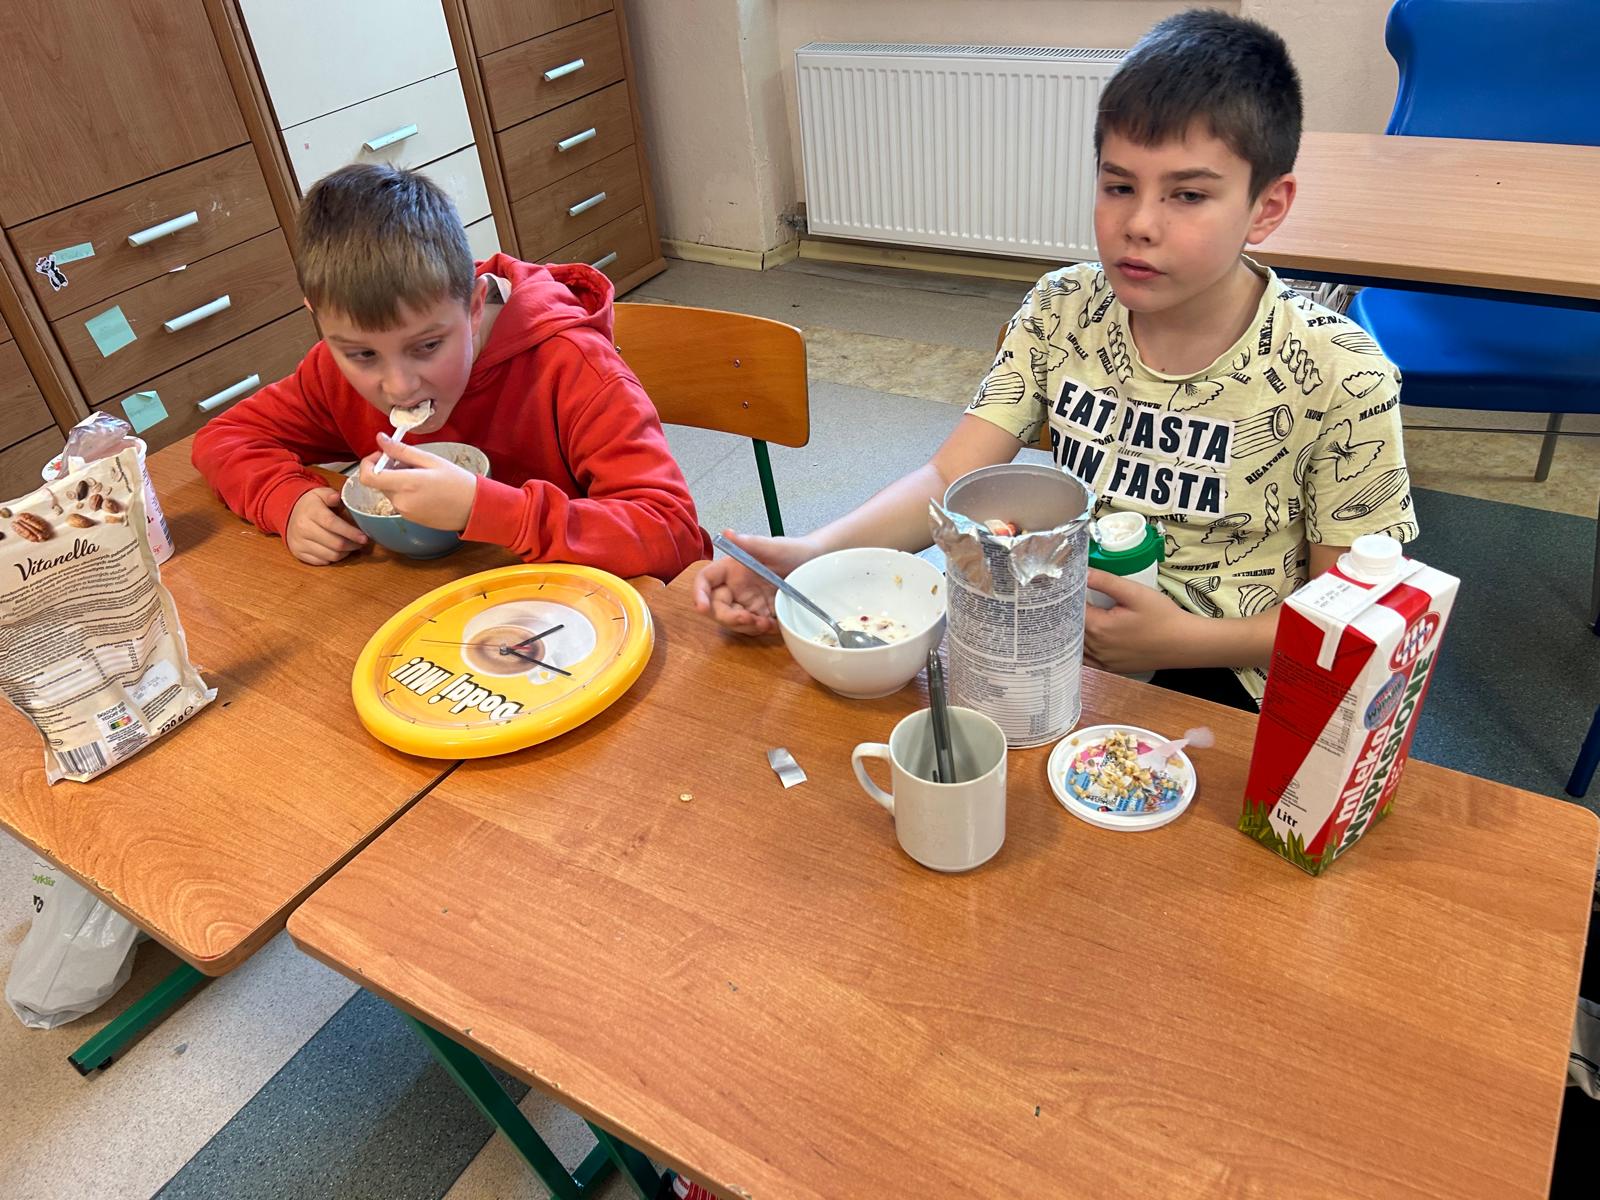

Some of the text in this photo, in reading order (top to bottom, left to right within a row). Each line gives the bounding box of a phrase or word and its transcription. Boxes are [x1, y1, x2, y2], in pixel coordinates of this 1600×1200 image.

[1096, 346, 1115, 376] FUSILLI
[1054, 380, 1118, 435] EAT
[1050, 425, 1106, 485] RUN
[1117, 405, 1231, 464] PASTA
[1108, 457, 1222, 514] FASTA
[1244, 446, 1290, 485] RIGATONI
[13, 537, 101, 582] Vitanella
[428, 672, 525, 725] Dodaj
[160, 720, 177, 734] 420
[1276, 807, 1299, 828] Litr
